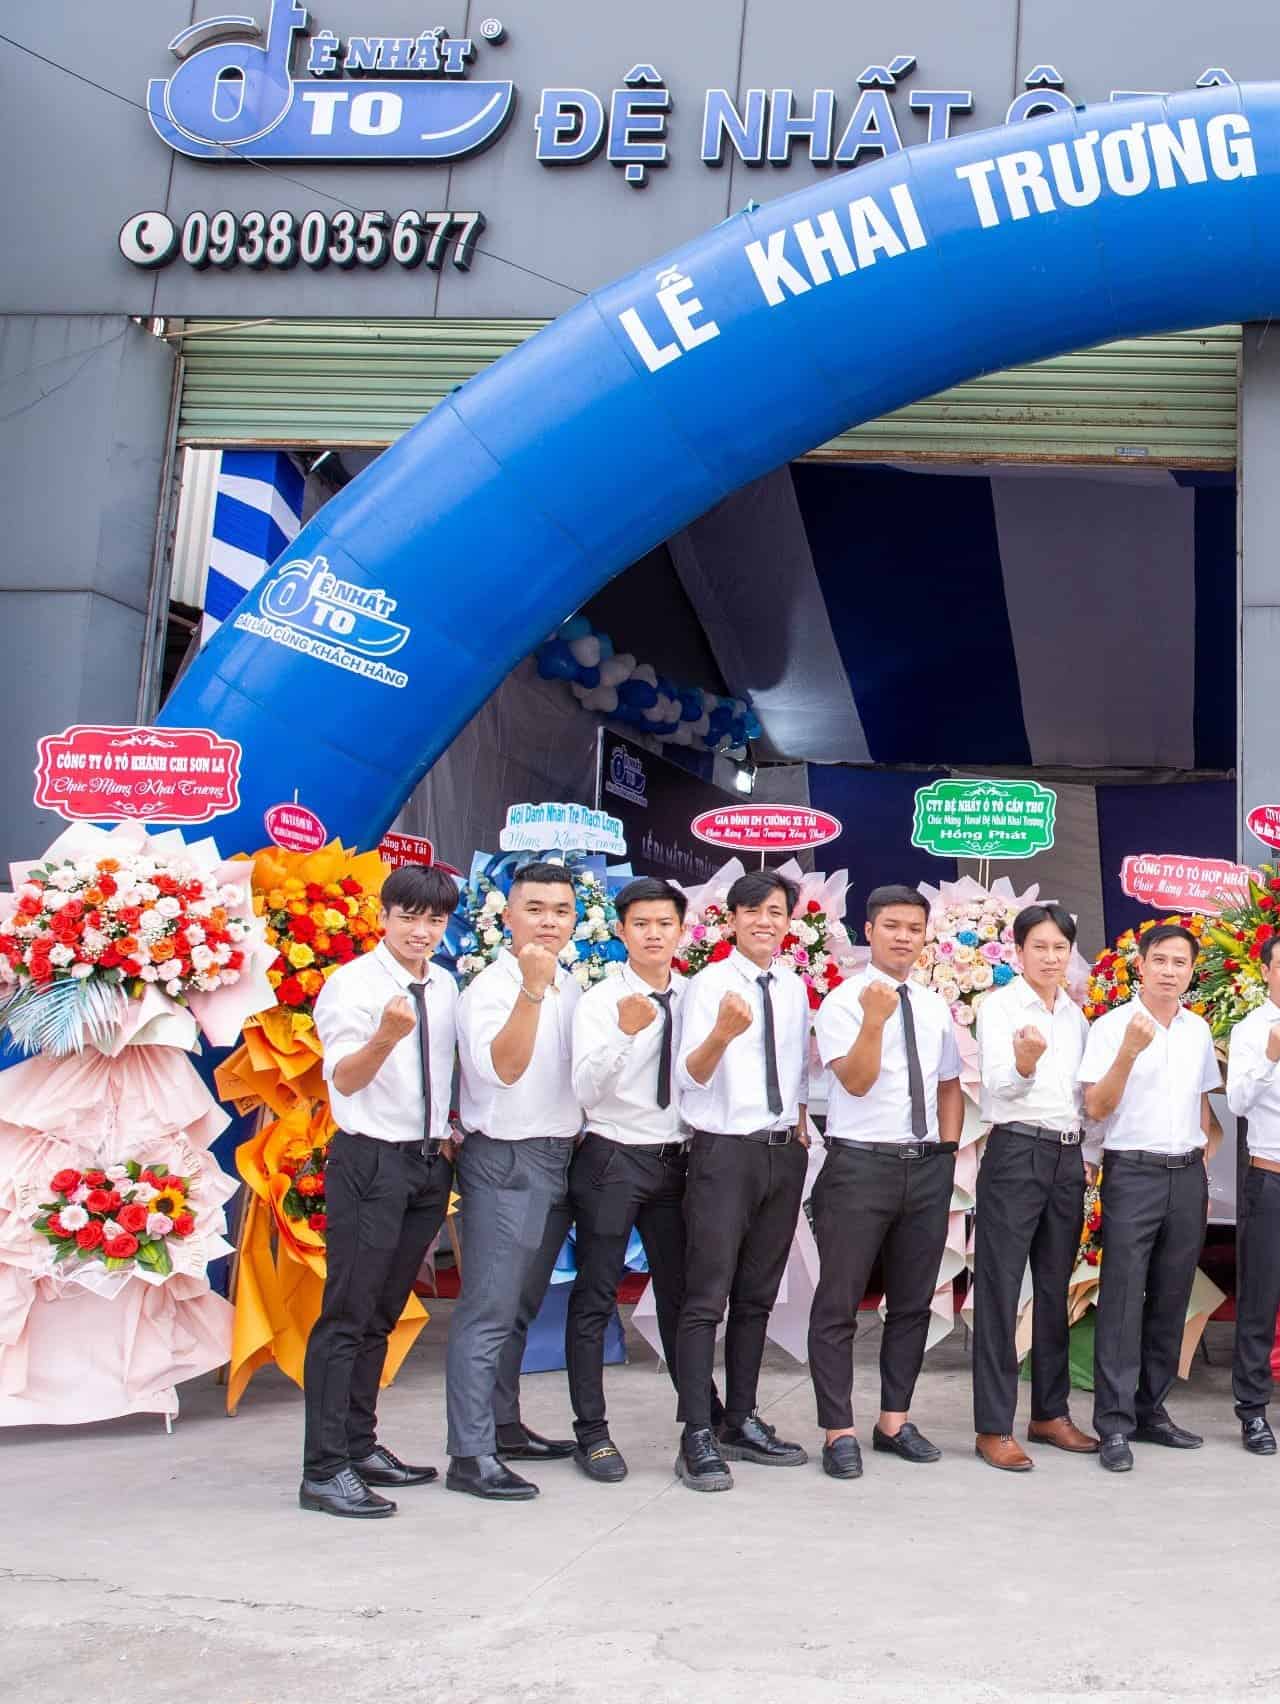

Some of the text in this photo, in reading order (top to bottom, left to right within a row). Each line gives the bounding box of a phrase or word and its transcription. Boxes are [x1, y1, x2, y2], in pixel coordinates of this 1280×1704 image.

[536, 63, 672, 187] ĐỆ
[701, 55, 973, 170] NHẤT
[617, 264, 721, 373] LỄ
[744, 183, 928, 307] KHAI
[955, 112, 1259, 229] TRƯƠNG
[273, 624, 309, 651] CÙNG
[310, 642, 363, 674] KHÁCH
[362, 660, 407, 687] HÀNG
[56, 750, 87, 769] CÔNG
[88, 753, 103, 770] TY
[715, 815, 729, 826] GIA
[1133, 861, 1161, 876] CÔNG
[1163, 864, 1175, 878] TY
[1175, 863, 1185, 880] Ô
[1186, 865, 1199, 881] TÔ
